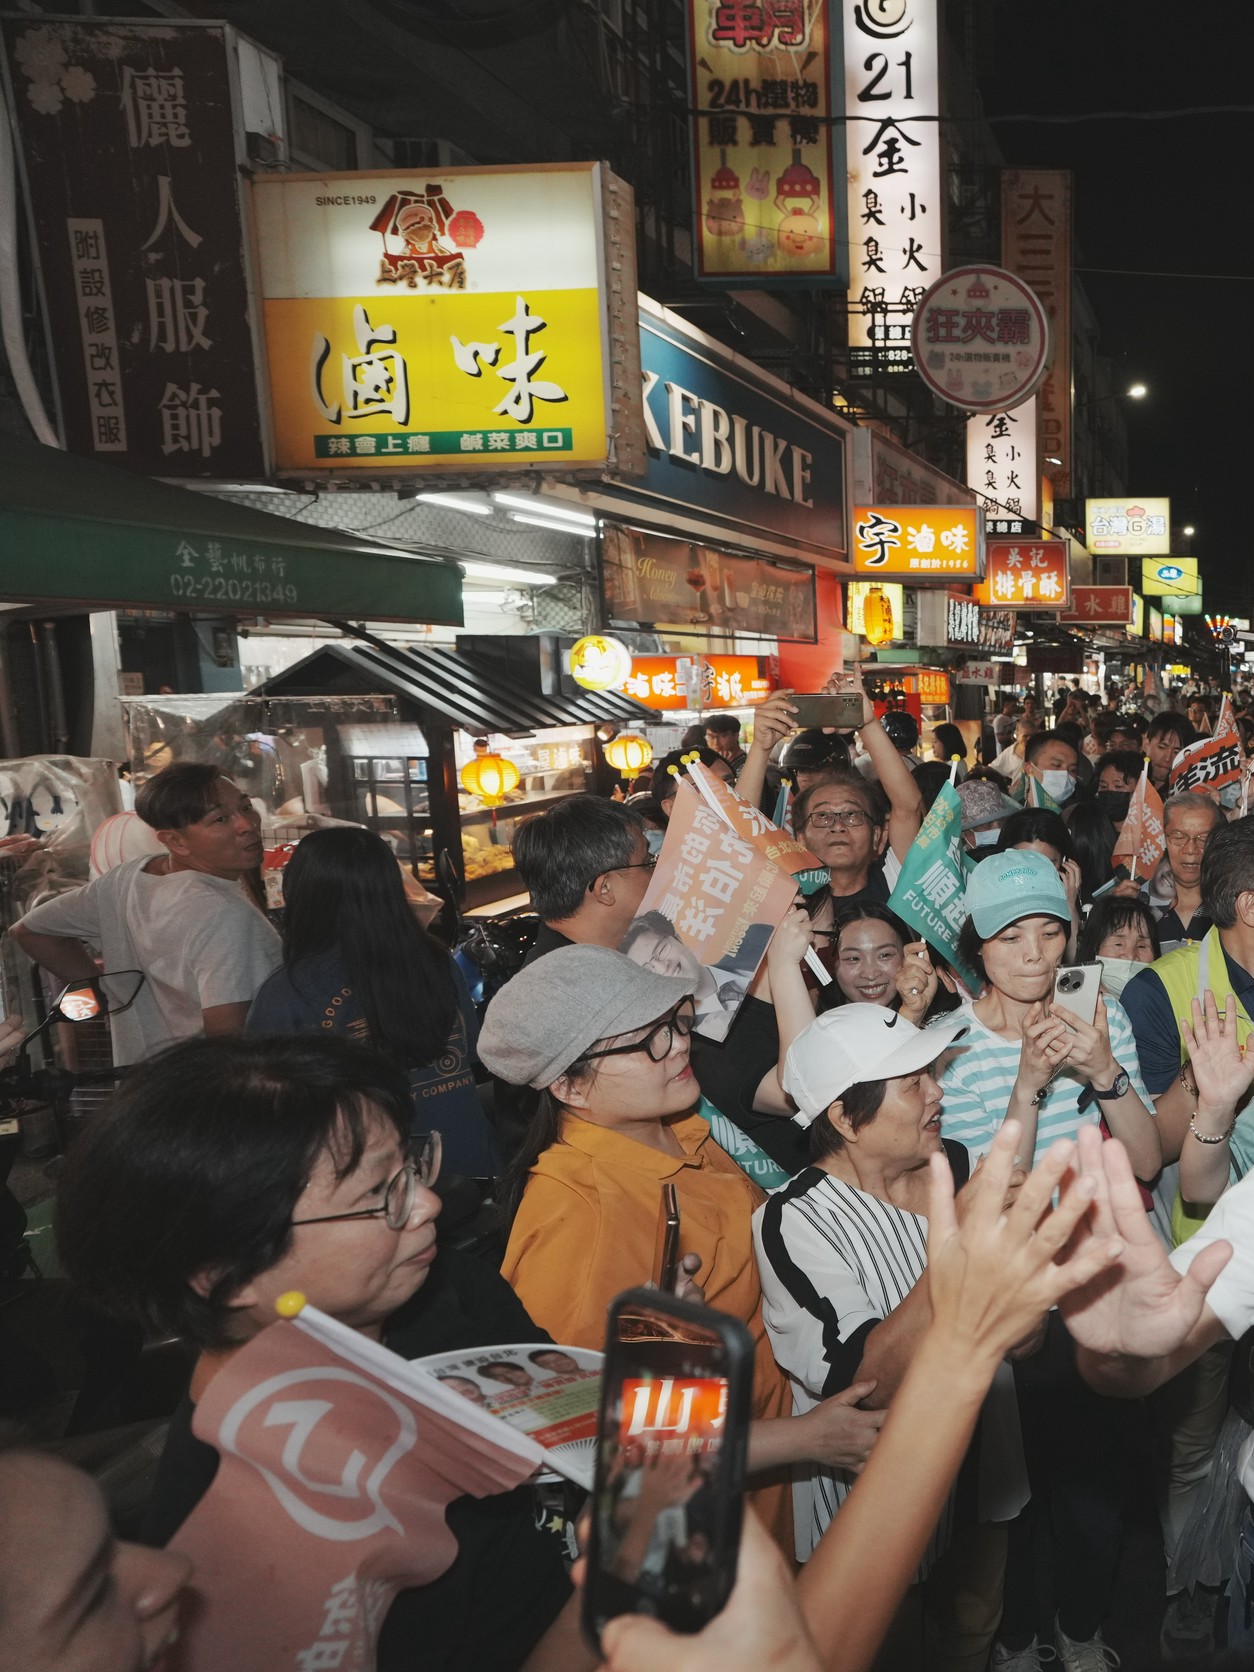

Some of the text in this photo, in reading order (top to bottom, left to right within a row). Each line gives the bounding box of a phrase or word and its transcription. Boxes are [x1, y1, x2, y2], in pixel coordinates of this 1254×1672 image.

[315, 195, 377, 206] SINCE1949
[118, 65, 224, 459] 儷人服飾
[74, 229, 123, 446] 附設修改衣服
[926, 307, 1031, 345] 狂夾霸
[310, 295, 569, 427] 滷味
[327, 431, 564, 456] 辣會上癮 鹹菜爽口
[641, 370, 814, 508] KEBUKE
[906, 523, 970, 554] 滷味
[1006, 547, 1048, 568] 吳記
[995, 570, 1062, 599] 排骨酥
[902, 890, 953, 943] FUTURE
[321, 987, 352, 1029] GOOD
[422, 1075, 476, 1098] COMPANY
